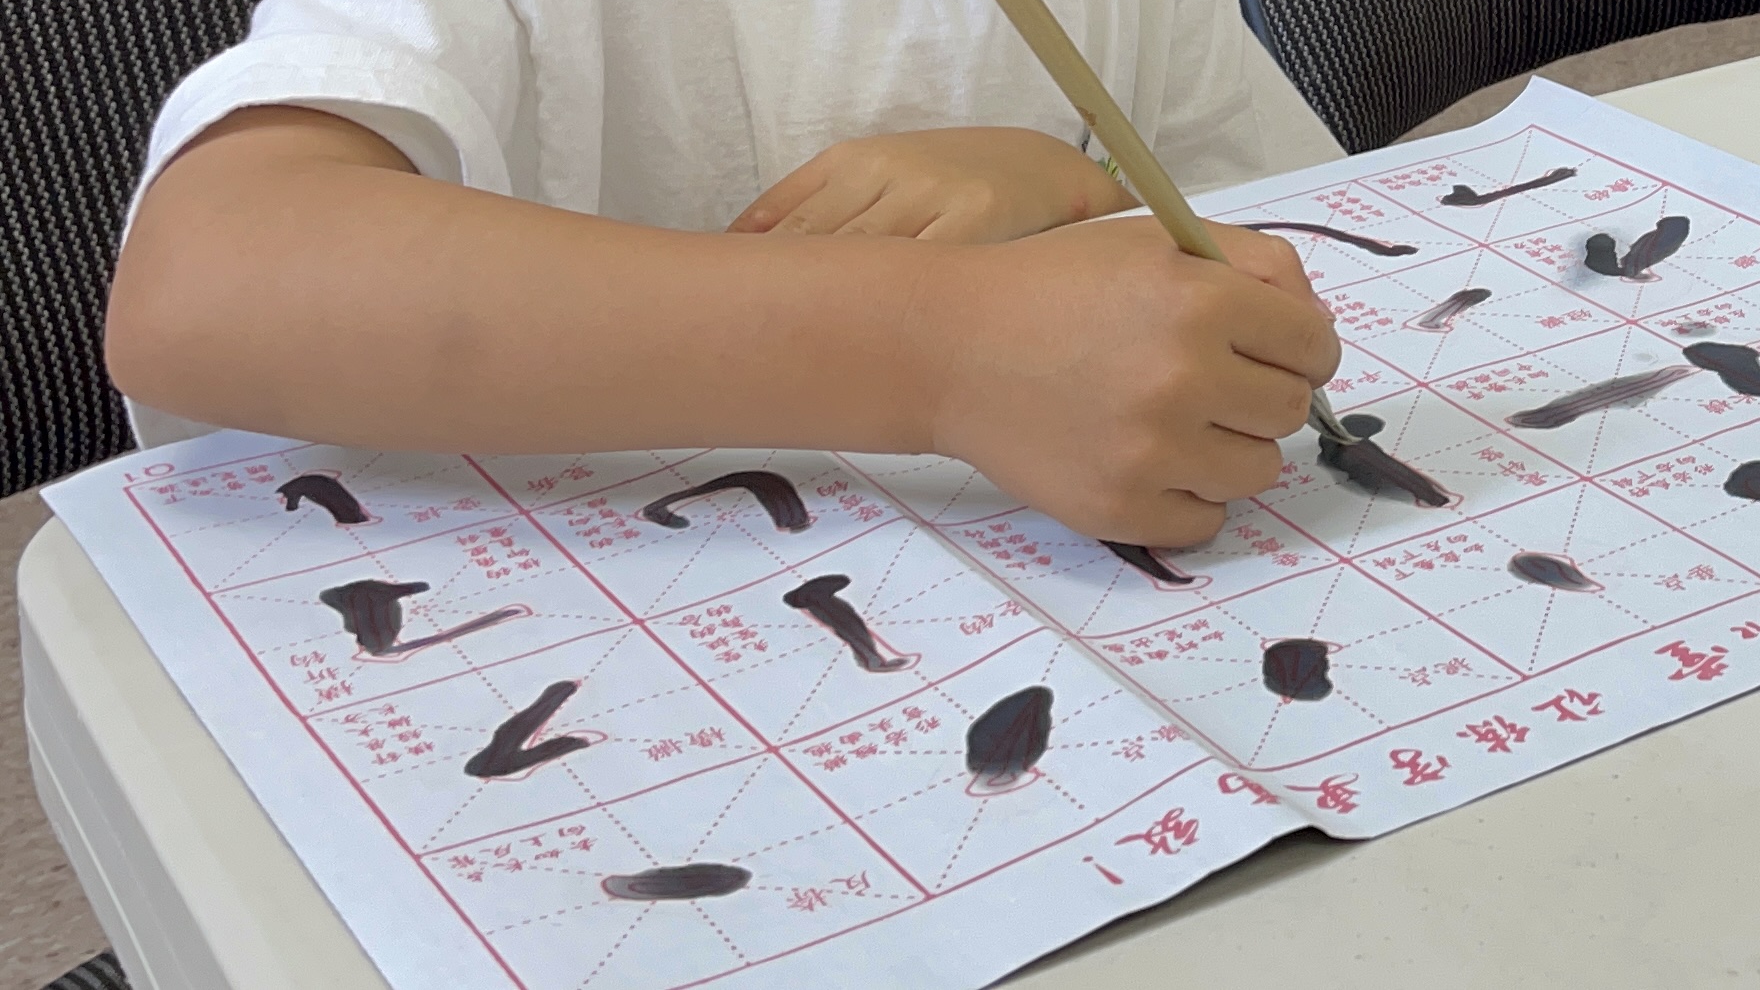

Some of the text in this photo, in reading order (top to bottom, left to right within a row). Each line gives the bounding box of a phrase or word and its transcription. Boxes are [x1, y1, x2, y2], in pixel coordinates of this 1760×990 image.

[1585, 179, 1634, 200] 横钩
[1540, 312, 1588, 328] 短撇
[1328, 373, 1379, 392] 平捺
[125, 463, 175, 482] Q1
[529, 468, 592, 489] 竖折
[1480, 448, 1545, 486] 悬针竖
[1612, 456, 1695, 488] 向右下斜
[415, 499, 476, 521] 竖提
[817, 482, 882, 521] 竖弯钩
[1237, 526, 1299, 566] 垂露竖
[1373, 534, 1467, 569] 向左下斜
[1664, 565, 1715, 590] 垂点
[290, 651, 352, 701] 横折钩
[1410, 659, 1471, 686] 挑点
[646, 728, 723, 761] 横撇
[789, 873, 871, 912] 反捺
